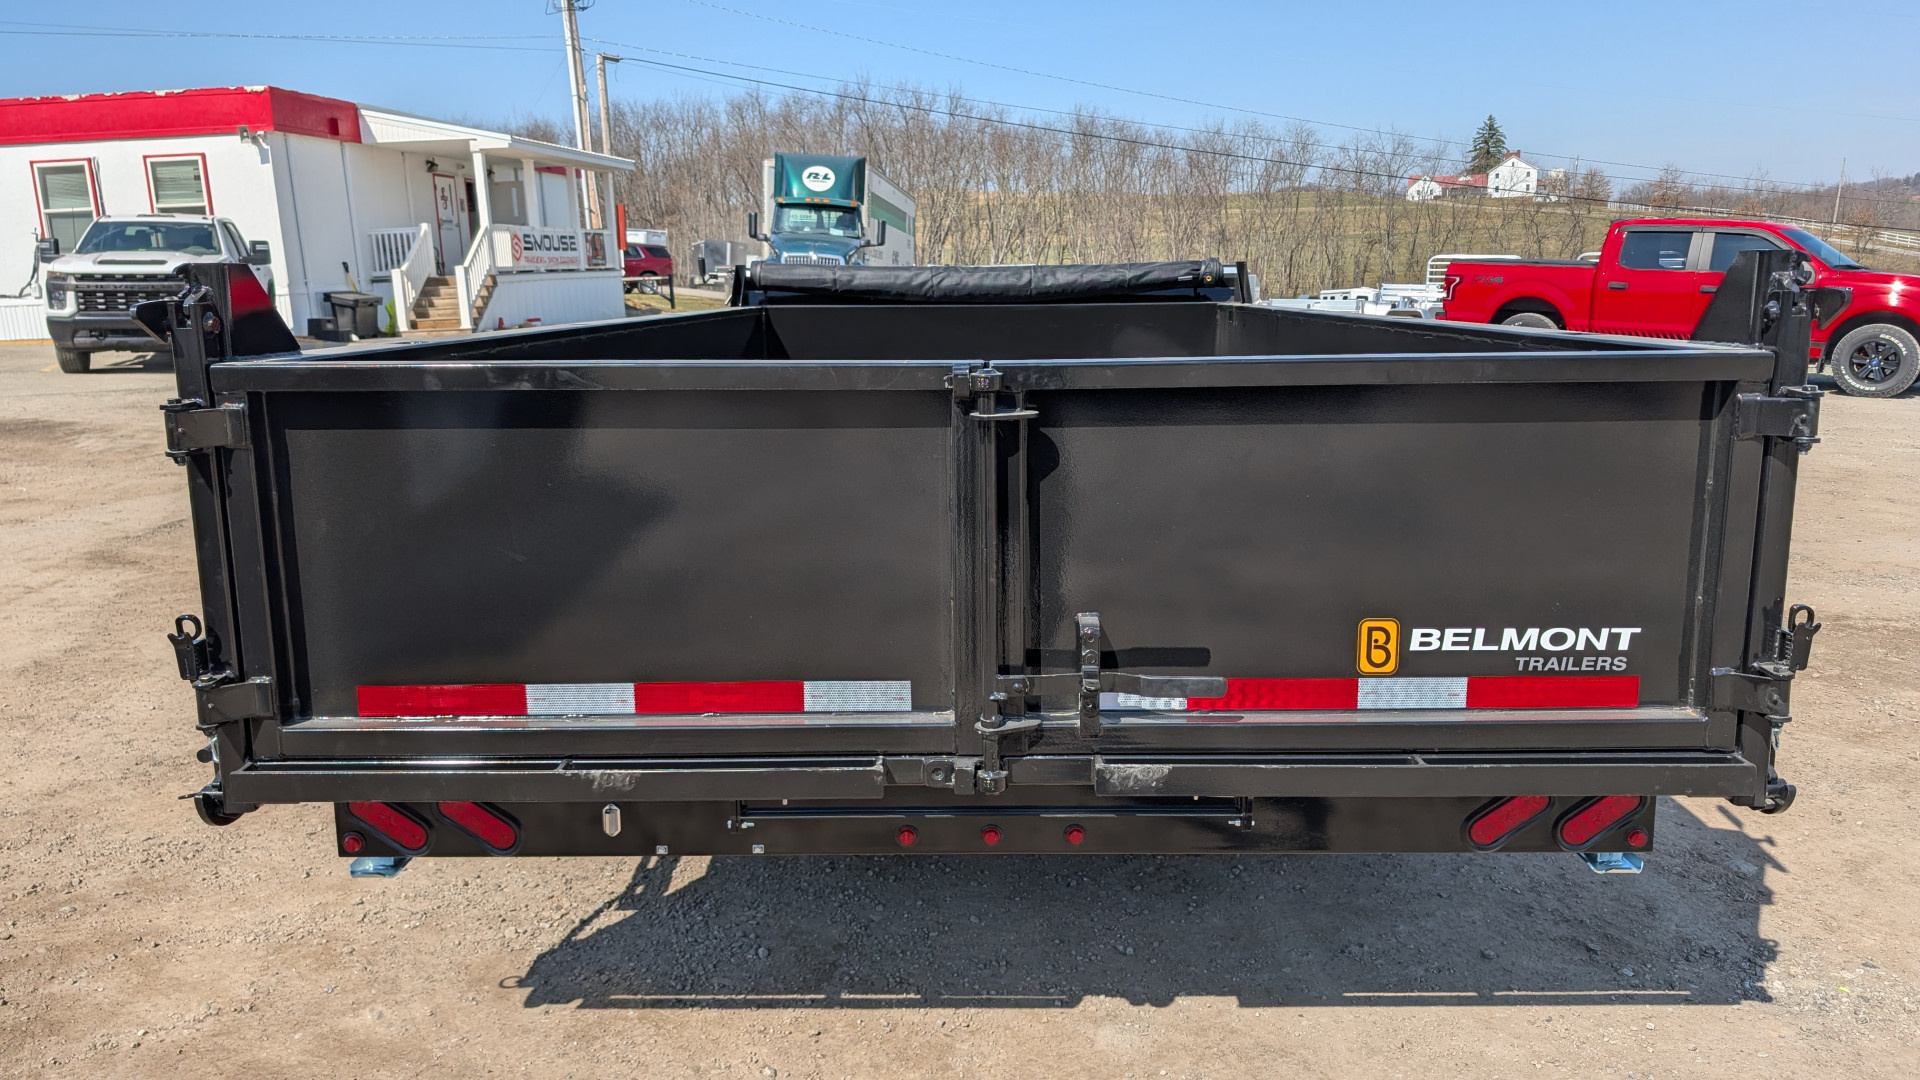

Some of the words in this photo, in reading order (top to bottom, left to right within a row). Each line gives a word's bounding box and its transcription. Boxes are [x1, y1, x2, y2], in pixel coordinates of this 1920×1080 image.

[523, 234, 577, 252] SMOUSE
[1879, 333, 1909, 357] GENERAL
[1409, 627, 1642, 651] BELMONT
[1515, 656, 1628, 672] TRAILERS
